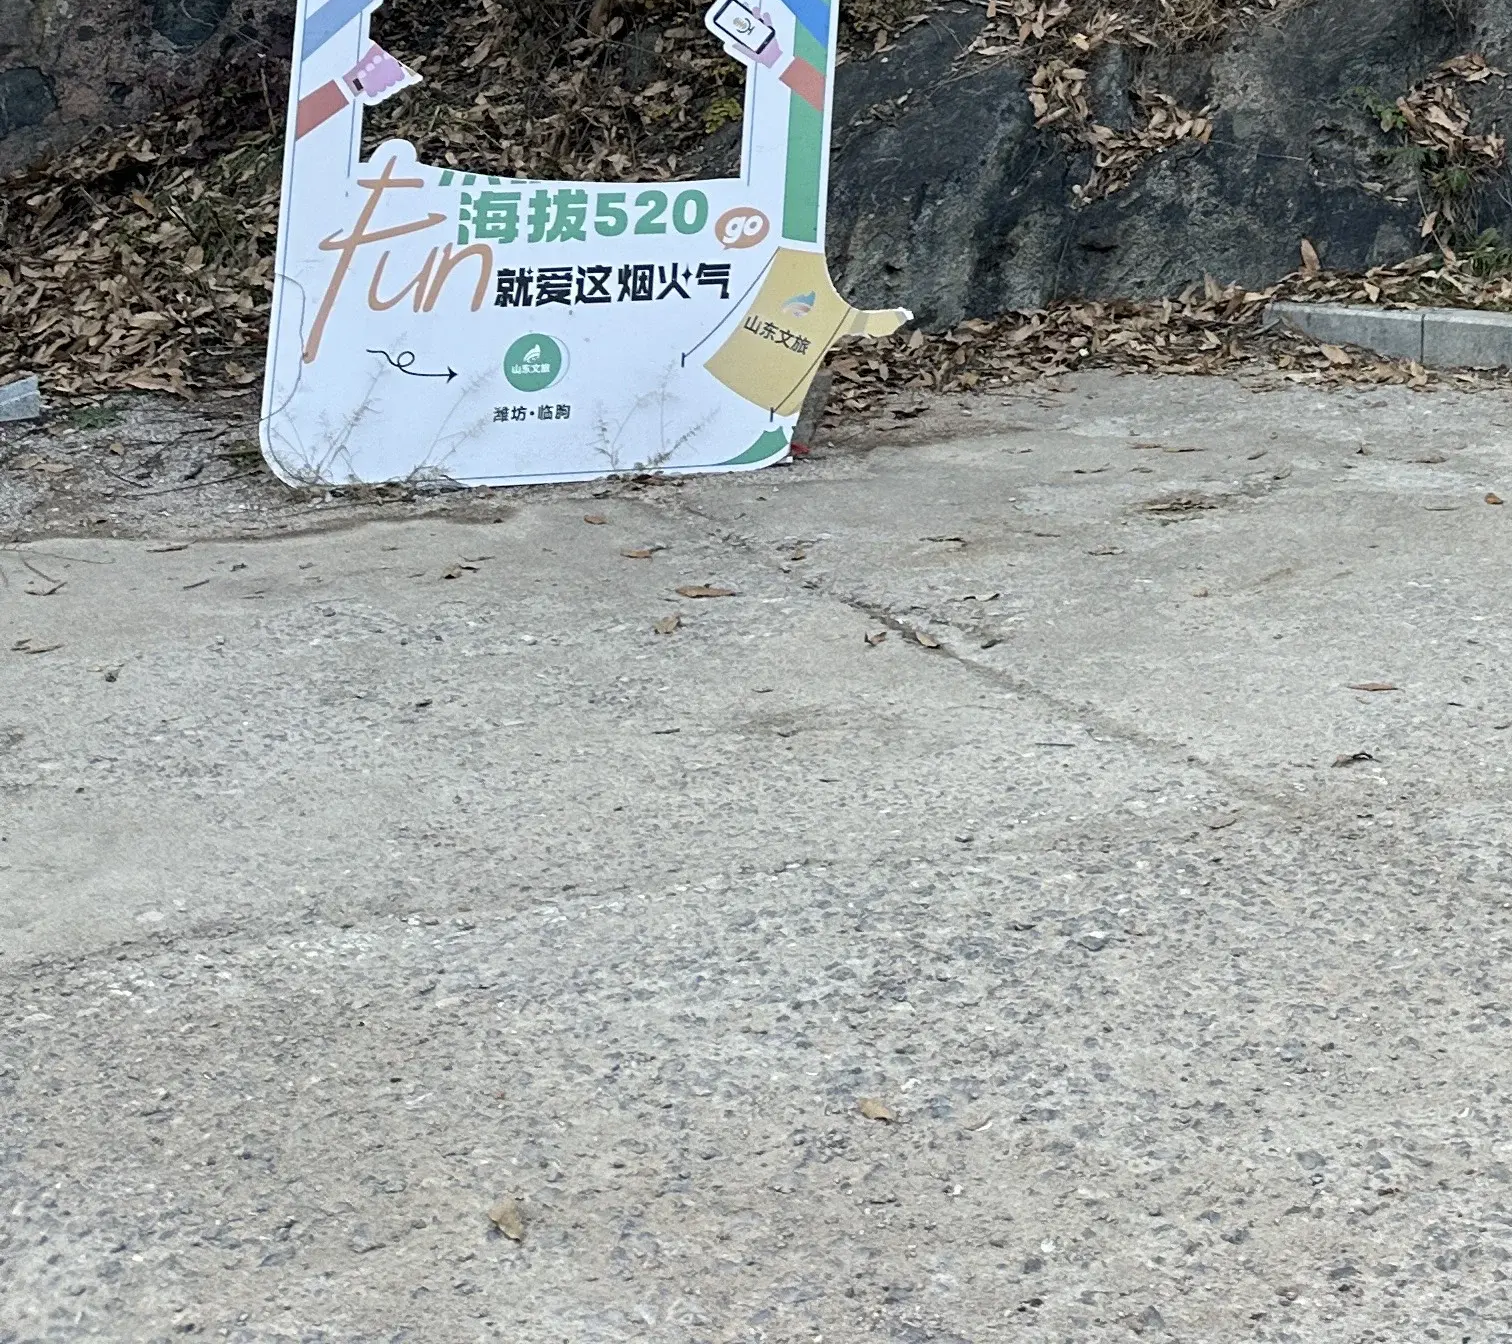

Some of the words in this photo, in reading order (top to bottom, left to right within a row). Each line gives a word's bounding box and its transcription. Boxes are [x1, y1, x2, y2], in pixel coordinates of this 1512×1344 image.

[456, 188, 709, 245] 海拔520
[722, 214, 764, 244] go
[493, 262, 732, 309] 就爱这烟火气
[743, 314, 812, 356] 山东文旅
[511, 363, 551, 375] 山东文旅
